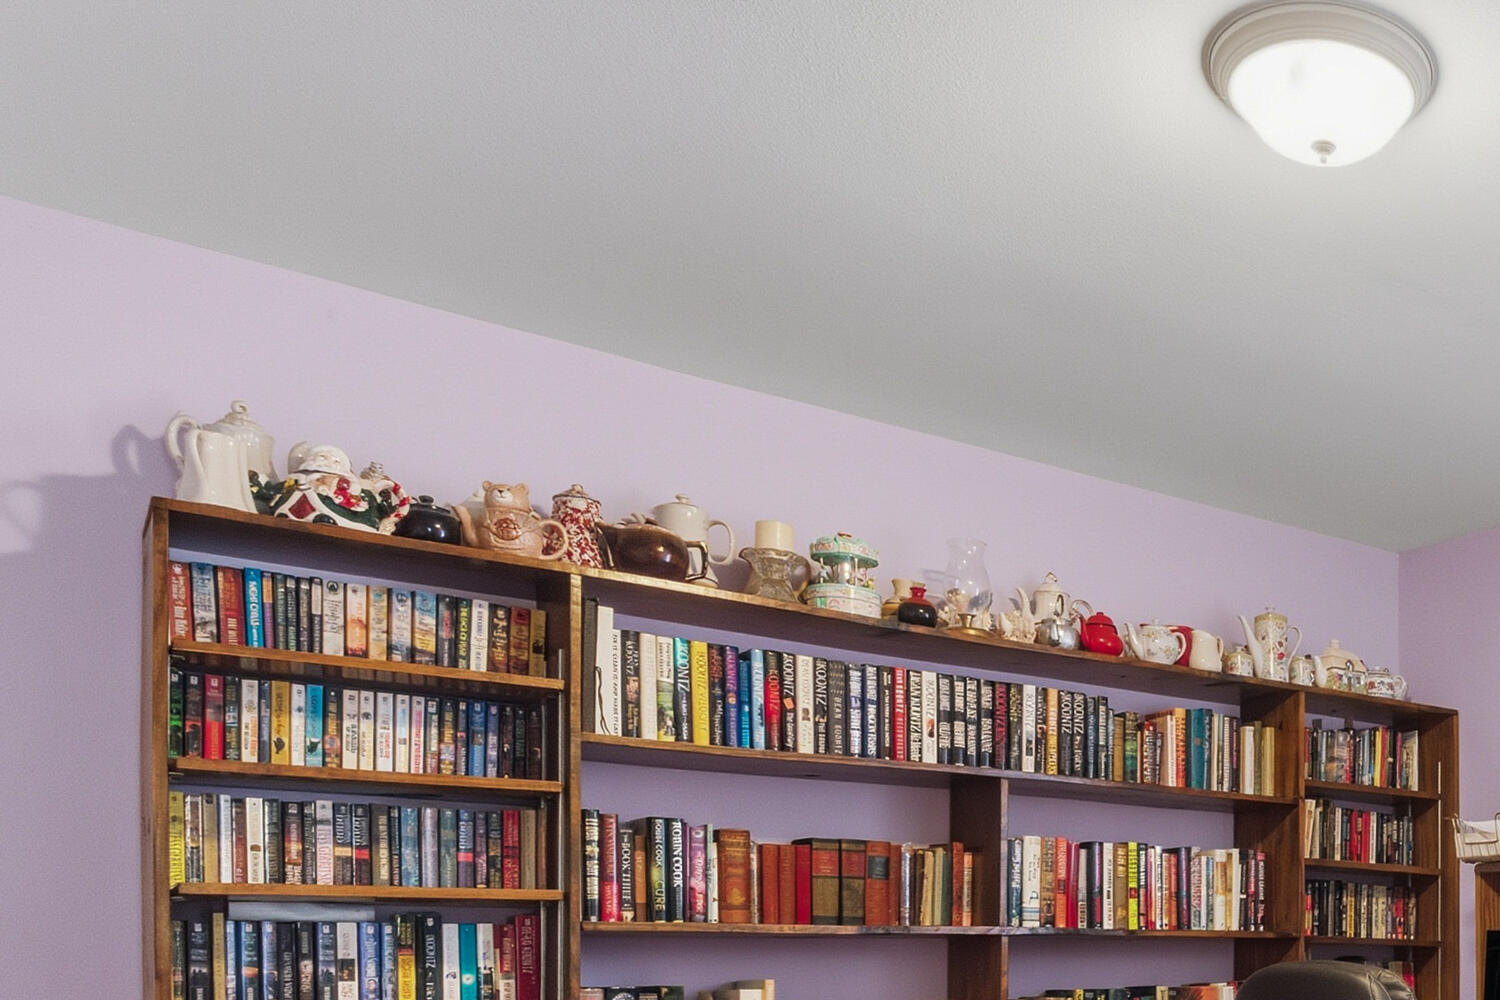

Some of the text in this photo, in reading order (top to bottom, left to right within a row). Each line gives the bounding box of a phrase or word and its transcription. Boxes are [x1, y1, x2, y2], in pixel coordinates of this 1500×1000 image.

[677, 643, 690, 693] KOONTZ
[697, 651, 708, 691] KOONTZ
[783, 654, 794, 696] KOONTZ
[815, 661, 827, 706] KOONTZ
[1060, 692, 1072, 735] KOONTZ
[1073, 693, 1085, 735] KOONTZ
[621, 842, 630, 870] BOOK
[655, 844, 663, 868] COOK
[672, 821, 683, 888] ROBIN COOK
[622, 872, 631, 903] THIEF
[655, 880, 665, 911] CURE
